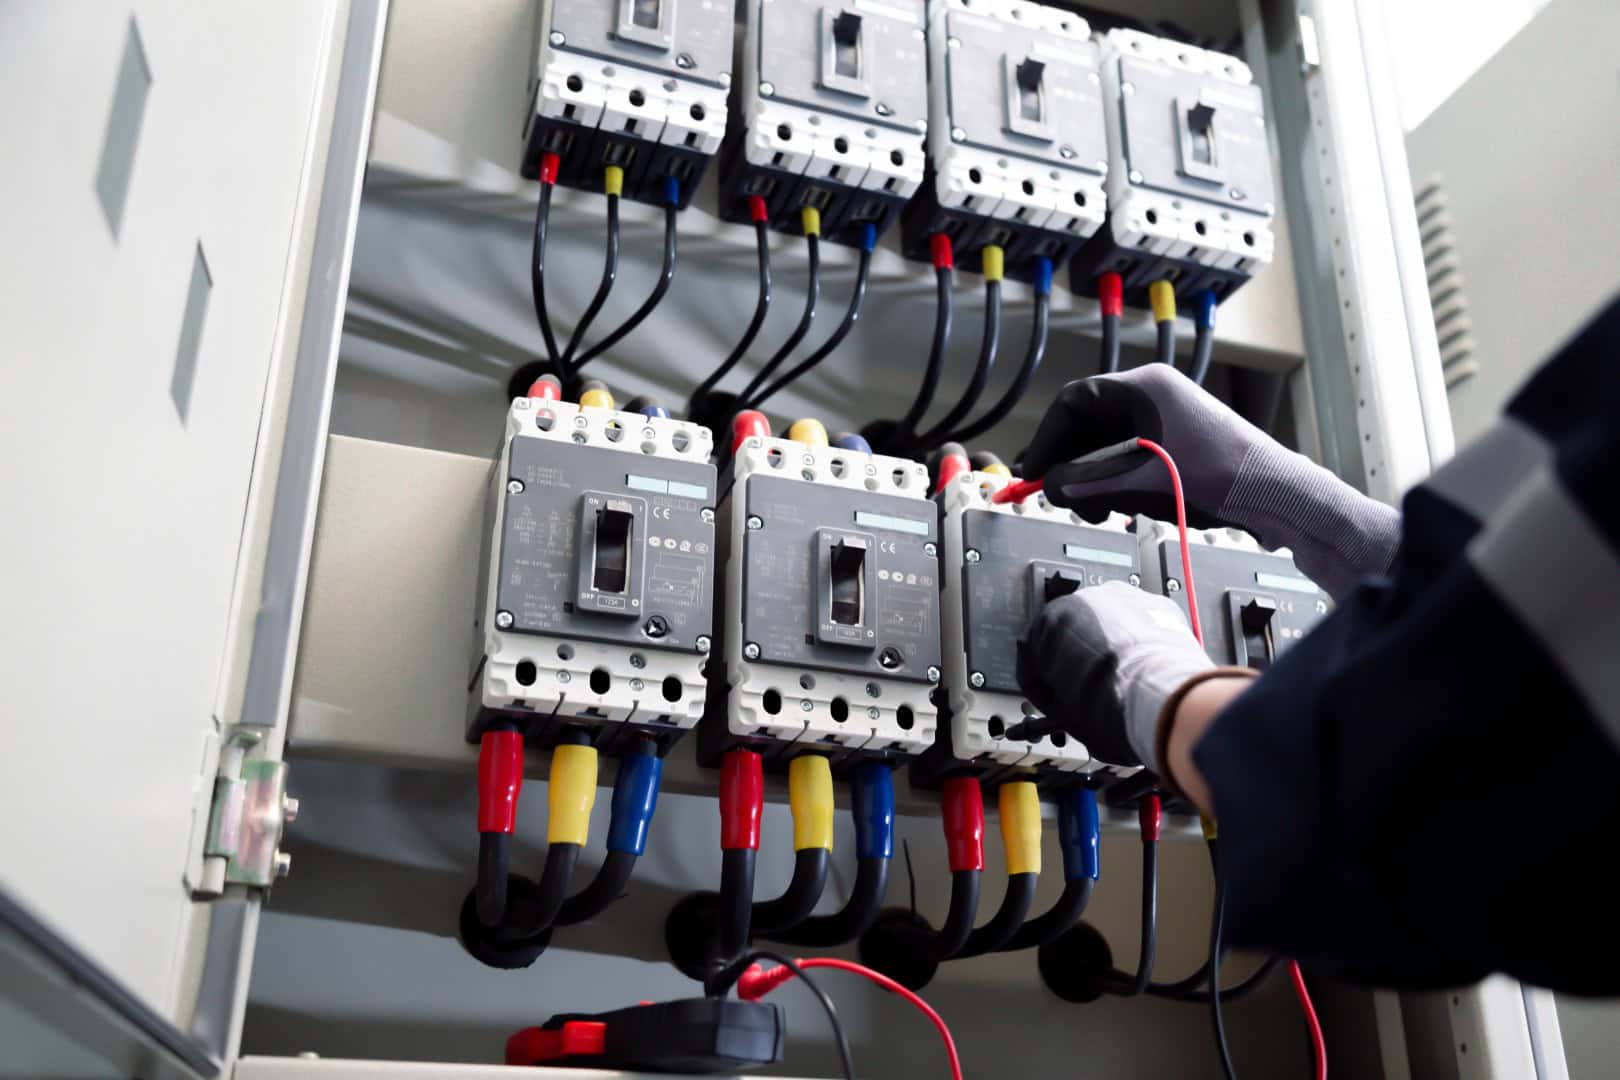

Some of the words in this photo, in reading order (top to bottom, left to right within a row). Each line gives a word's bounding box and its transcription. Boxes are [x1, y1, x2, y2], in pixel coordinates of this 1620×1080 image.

[588, 497, 599, 505] ON
[653, 506, 671, 520] CE
[880, 542, 896, 554] CE
